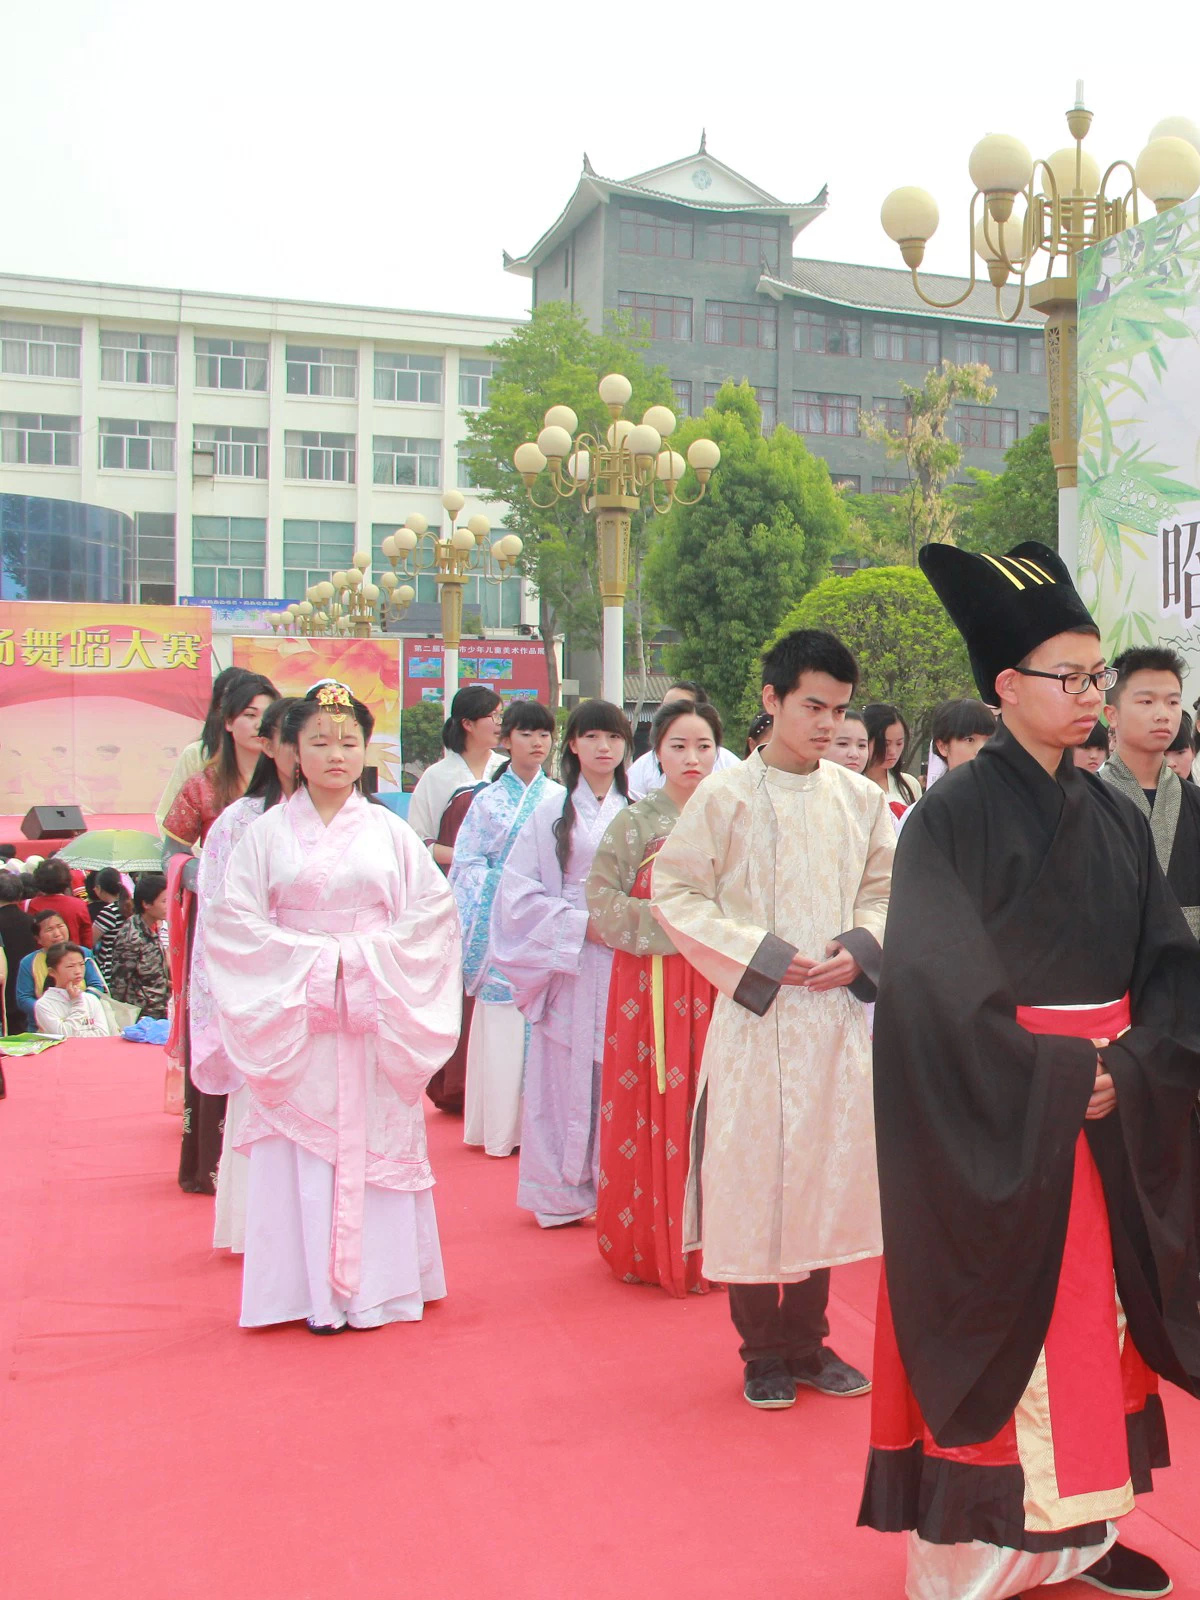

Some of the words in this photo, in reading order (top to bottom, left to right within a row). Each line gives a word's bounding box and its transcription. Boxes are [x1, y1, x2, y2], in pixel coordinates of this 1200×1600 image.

[414, 644, 545, 655] 第二届市少年儿童美术作品展
